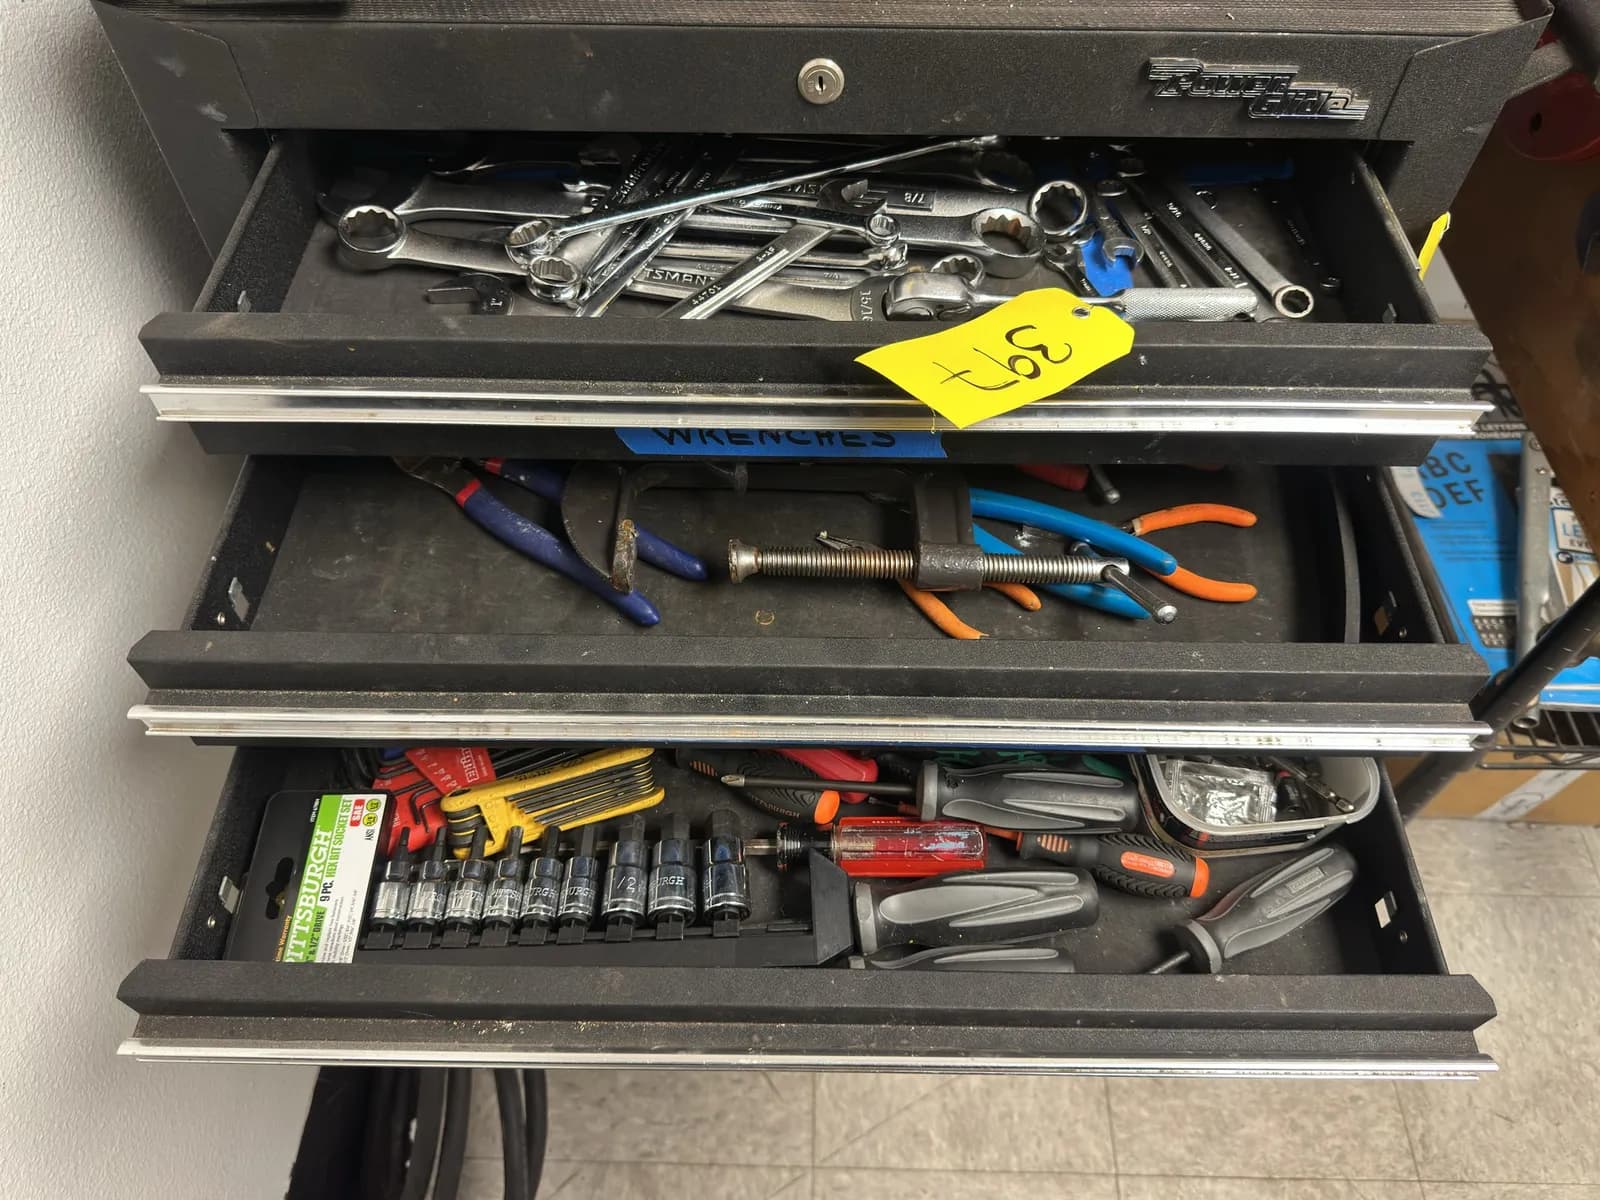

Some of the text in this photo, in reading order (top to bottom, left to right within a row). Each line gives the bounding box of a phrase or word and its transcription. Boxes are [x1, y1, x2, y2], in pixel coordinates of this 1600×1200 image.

[904, 192, 926, 204] 7/8
[1420, 452, 1472, 479] BC
[341, 798, 353, 813] SET
[351, 803, 364, 822] SAE
[333, 814, 349, 846] SOCKET
[329, 847, 342, 861] BIT
[325, 860, 339, 878] HEX
[321, 879, 334, 896] PC.
[319, 894, 331, 903] 9
[278, 914, 293, 946] Warranty
[313, 910, 326, 933] DRIVE
